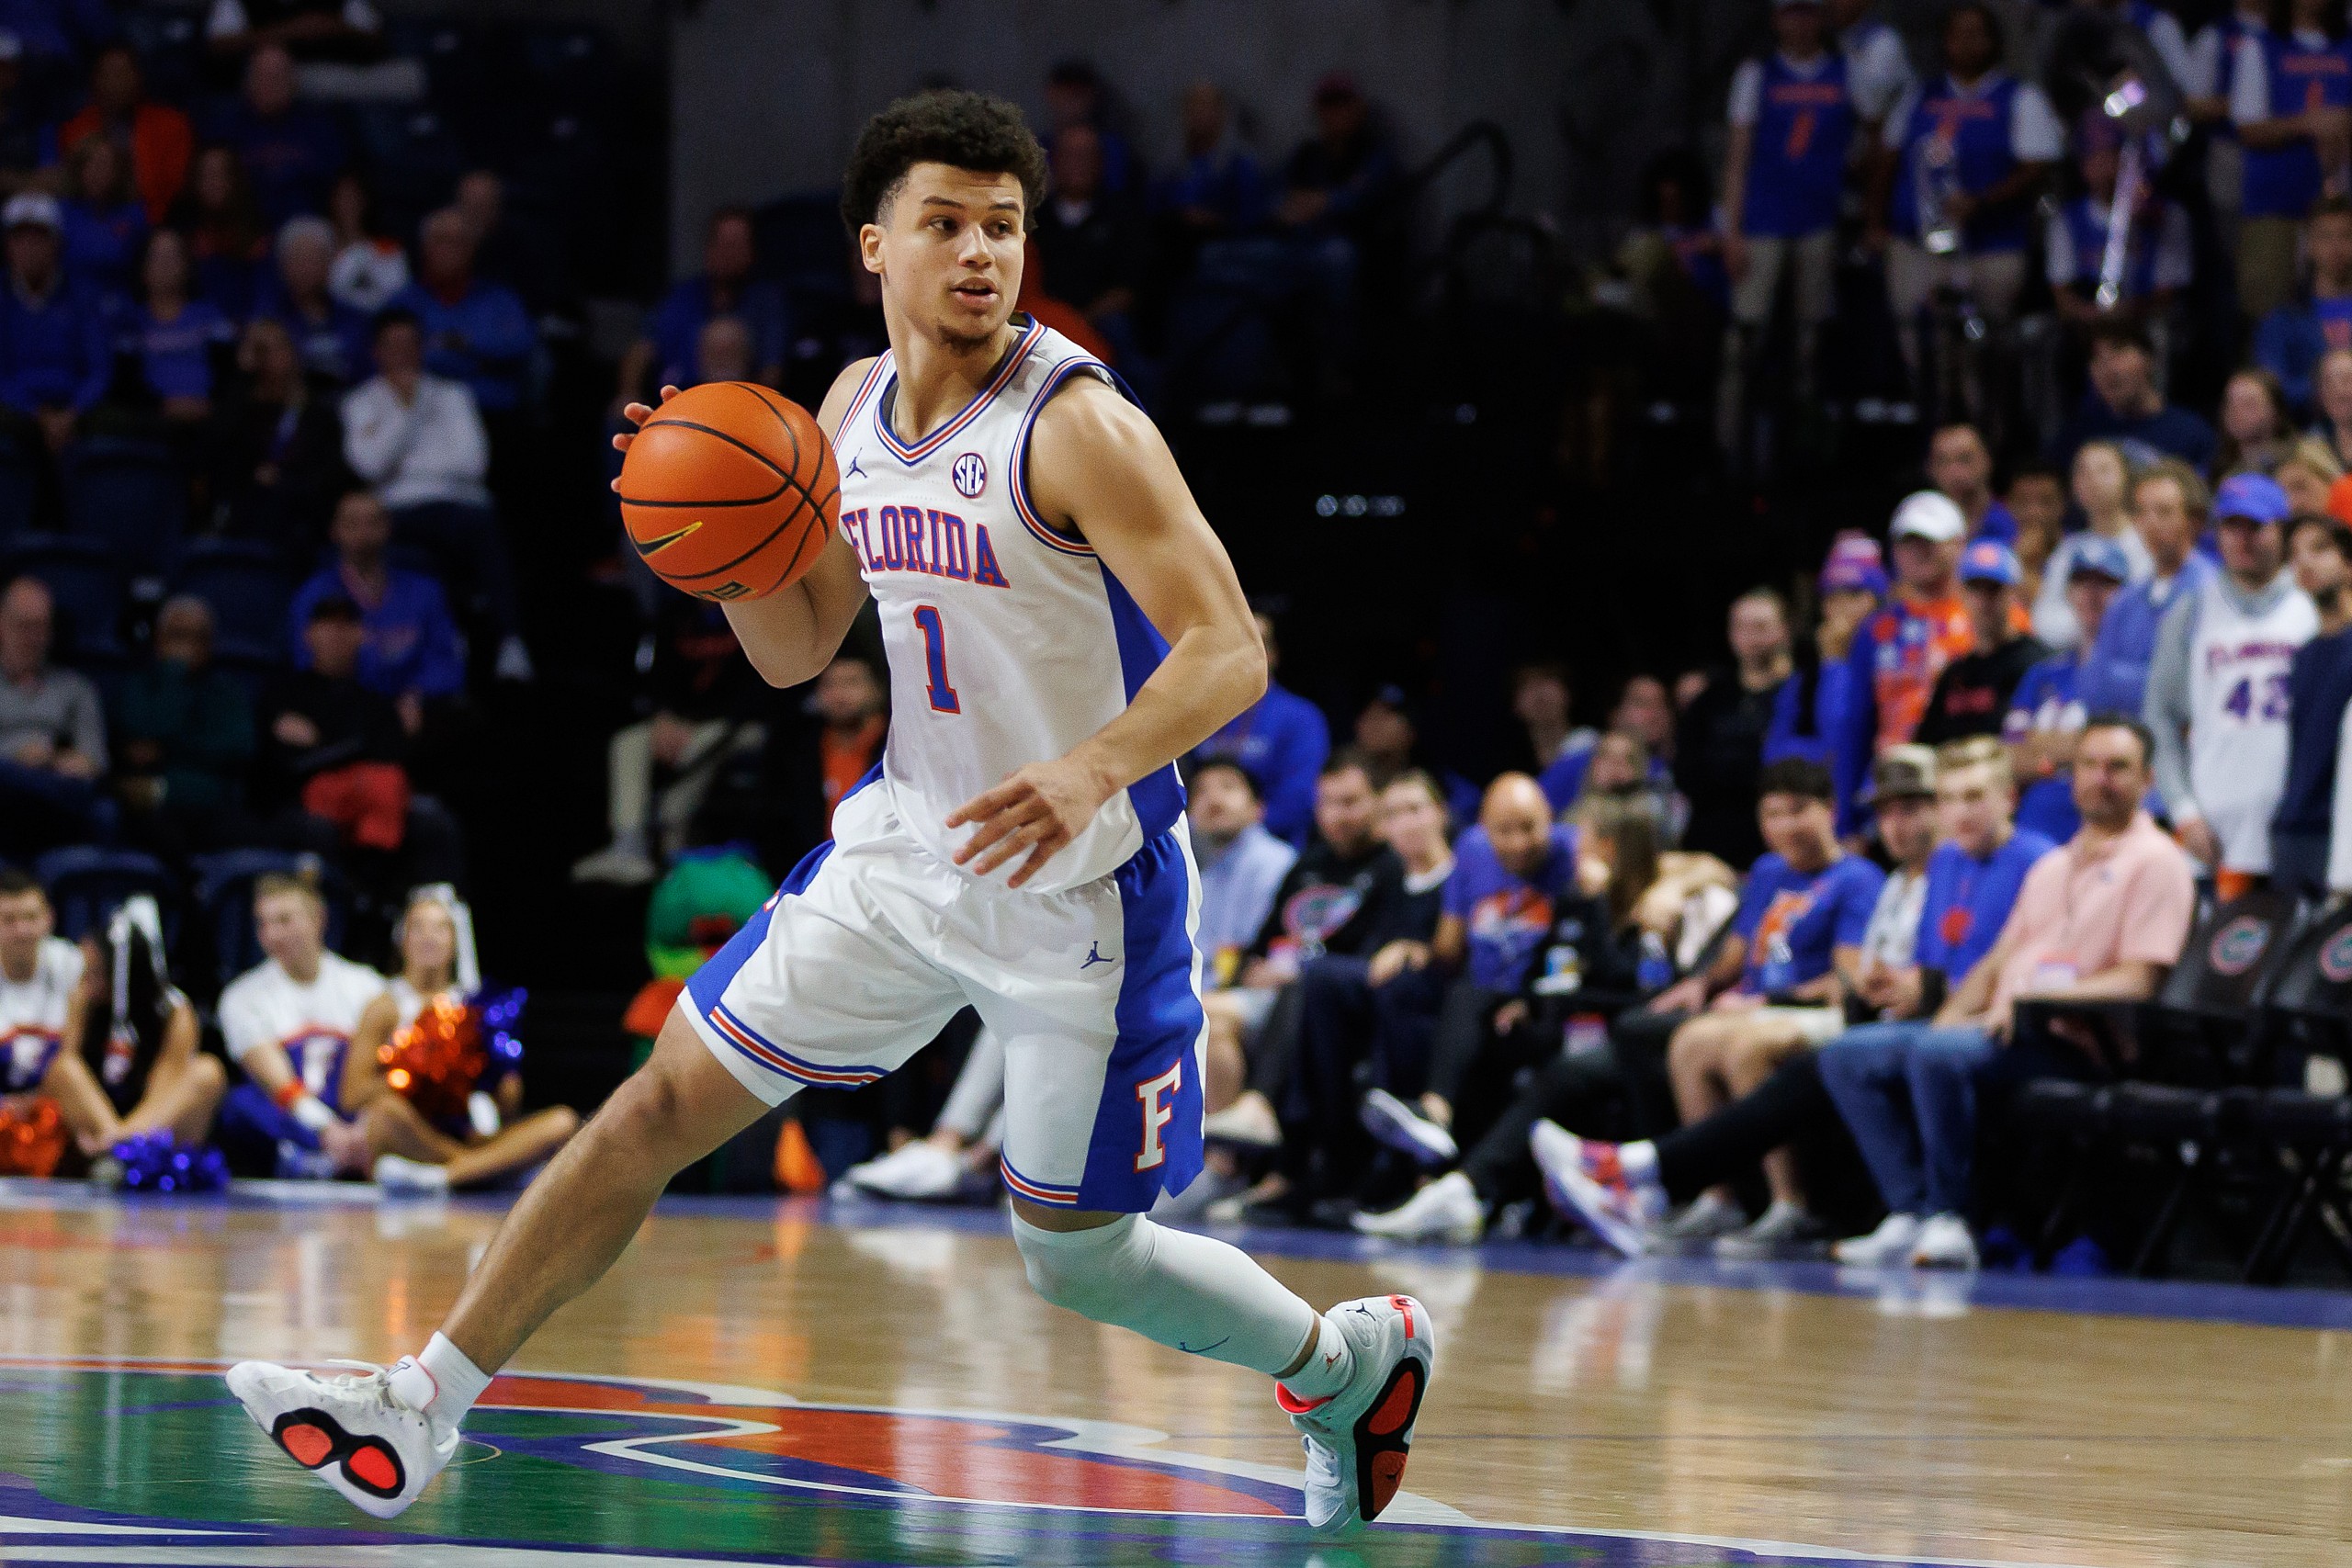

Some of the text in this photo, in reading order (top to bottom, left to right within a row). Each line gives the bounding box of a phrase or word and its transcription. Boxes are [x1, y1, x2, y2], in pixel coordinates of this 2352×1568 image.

[955, 456, 986, 496] SEC
[841, 505, 1011, 589] FLORIDA
[913, 604, 961, 715] 1
[1134, 1057, 1182, 1174] F
